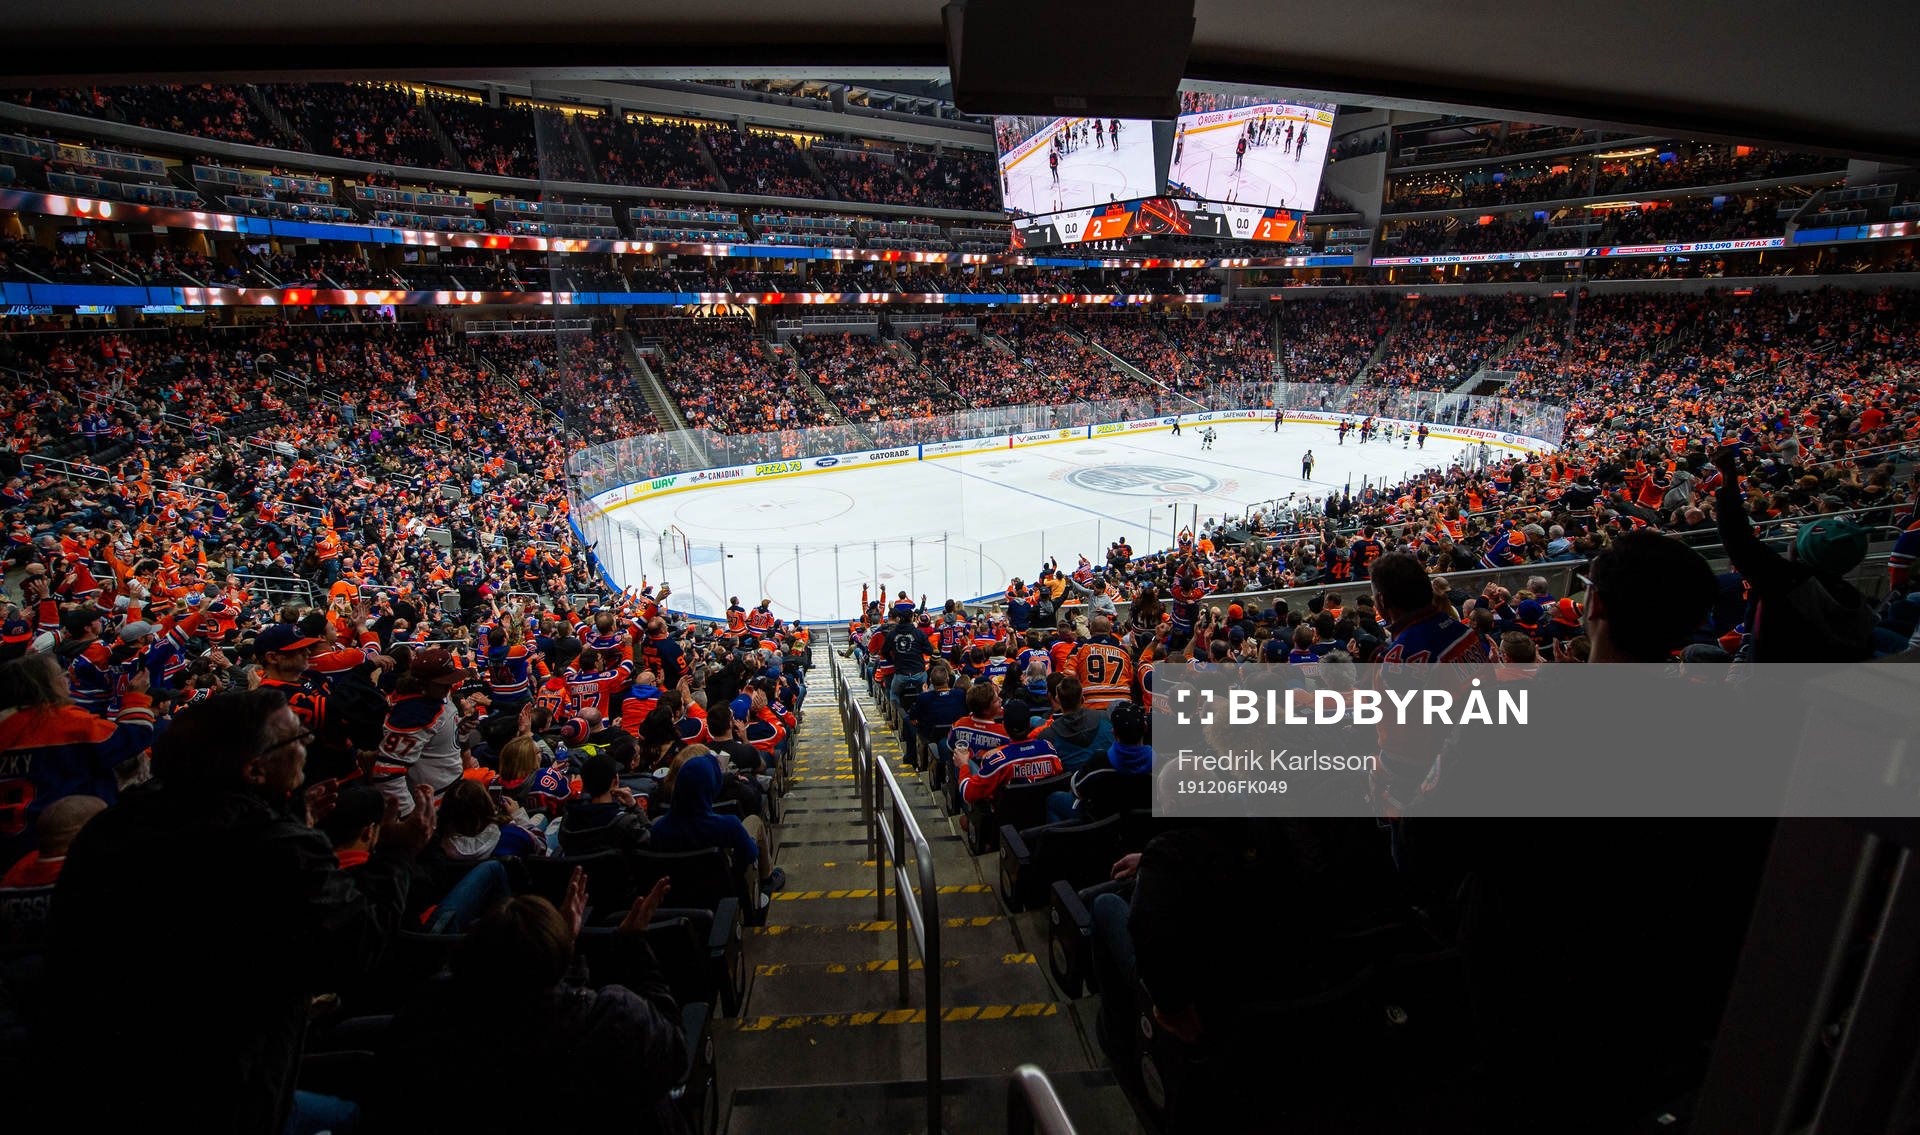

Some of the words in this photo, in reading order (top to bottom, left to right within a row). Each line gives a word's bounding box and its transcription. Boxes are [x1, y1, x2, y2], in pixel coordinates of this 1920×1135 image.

[1204, 113, 1225, 122] ROGERS
[1065, 223, 1078, 234] 0.0
[1093, 220, 1102, 238] 2
[1215, 217, 1222, 235] 1
[1236, 218, 1249, 229] 0.0
[1263, 221, 1271, 238] 2
[1045, 227, 1051, 243] 1
[1695, 242, 1731, 250] $133,090
[1734, 240, 1767, 248] RE/MAX
[1283, 411, 1298, 419] Tim
[1298, 412, 1323, 420] Hortons
[1097, 424, 1116, 433] PIZZA
[1129, 421, 1157, 429] Scotiabank
[870, 450, 910, 460] GATORADE
[756, 463, 787, 475] PIZZA
[790, 461, 802, 471] 73
[708, 469, 740, 480] CANADIAN
[633, 477, 677, 494] SUBWAY
[1090, 646, 1121, 656] McDAVID
[1087, 655, 1124, 684] 97
[384, 735, 416, 756] 97
[1014, 761, 1052, 777] McDAVID
[540, 767, 562, 791] 97
